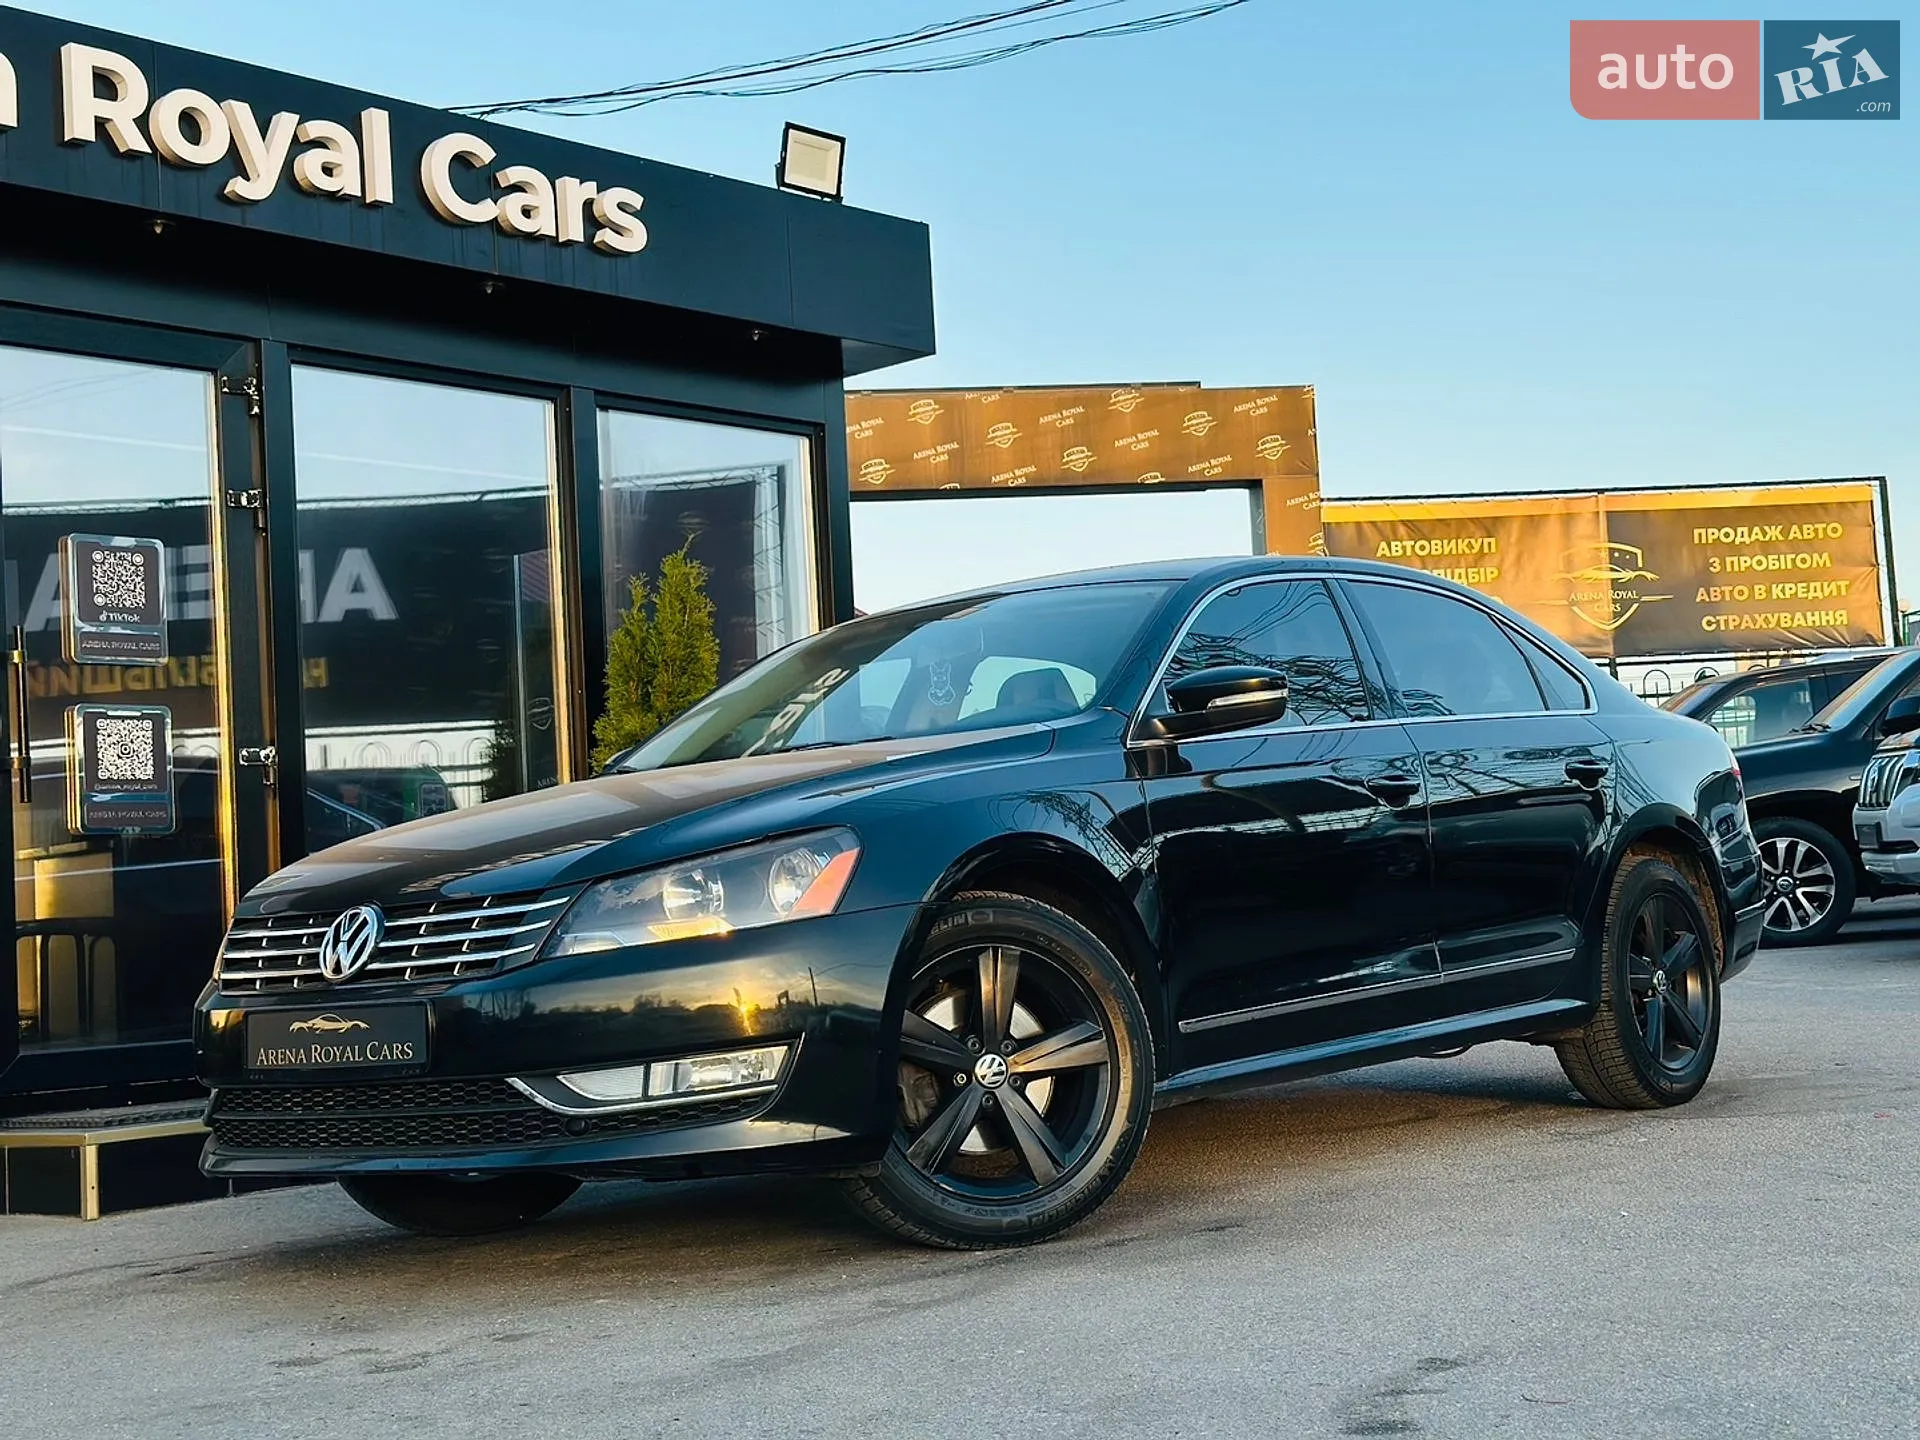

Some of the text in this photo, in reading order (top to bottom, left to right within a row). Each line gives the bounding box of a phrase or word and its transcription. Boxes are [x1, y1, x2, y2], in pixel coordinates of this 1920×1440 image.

[60, 41, 394, 207] Royal
[421, 132, 648, 255] Cars
[1693, 522, 1843, 545] ПРОДАЖ АВТО
[1376, 537, 1496, 557] АВТОВИКУП
[1708, 552, 1832, 573] З ПРОБІГОМ
[1608, 590, 1639, 600] ROYAL
[1695, 580, 1850, 603] АВТО В КРЕДИТ
[1701, 609, 1848, 632] СТРАХУВАННЯ
[257, 1041, 413, 1066] ARENA ROYAL CARS
